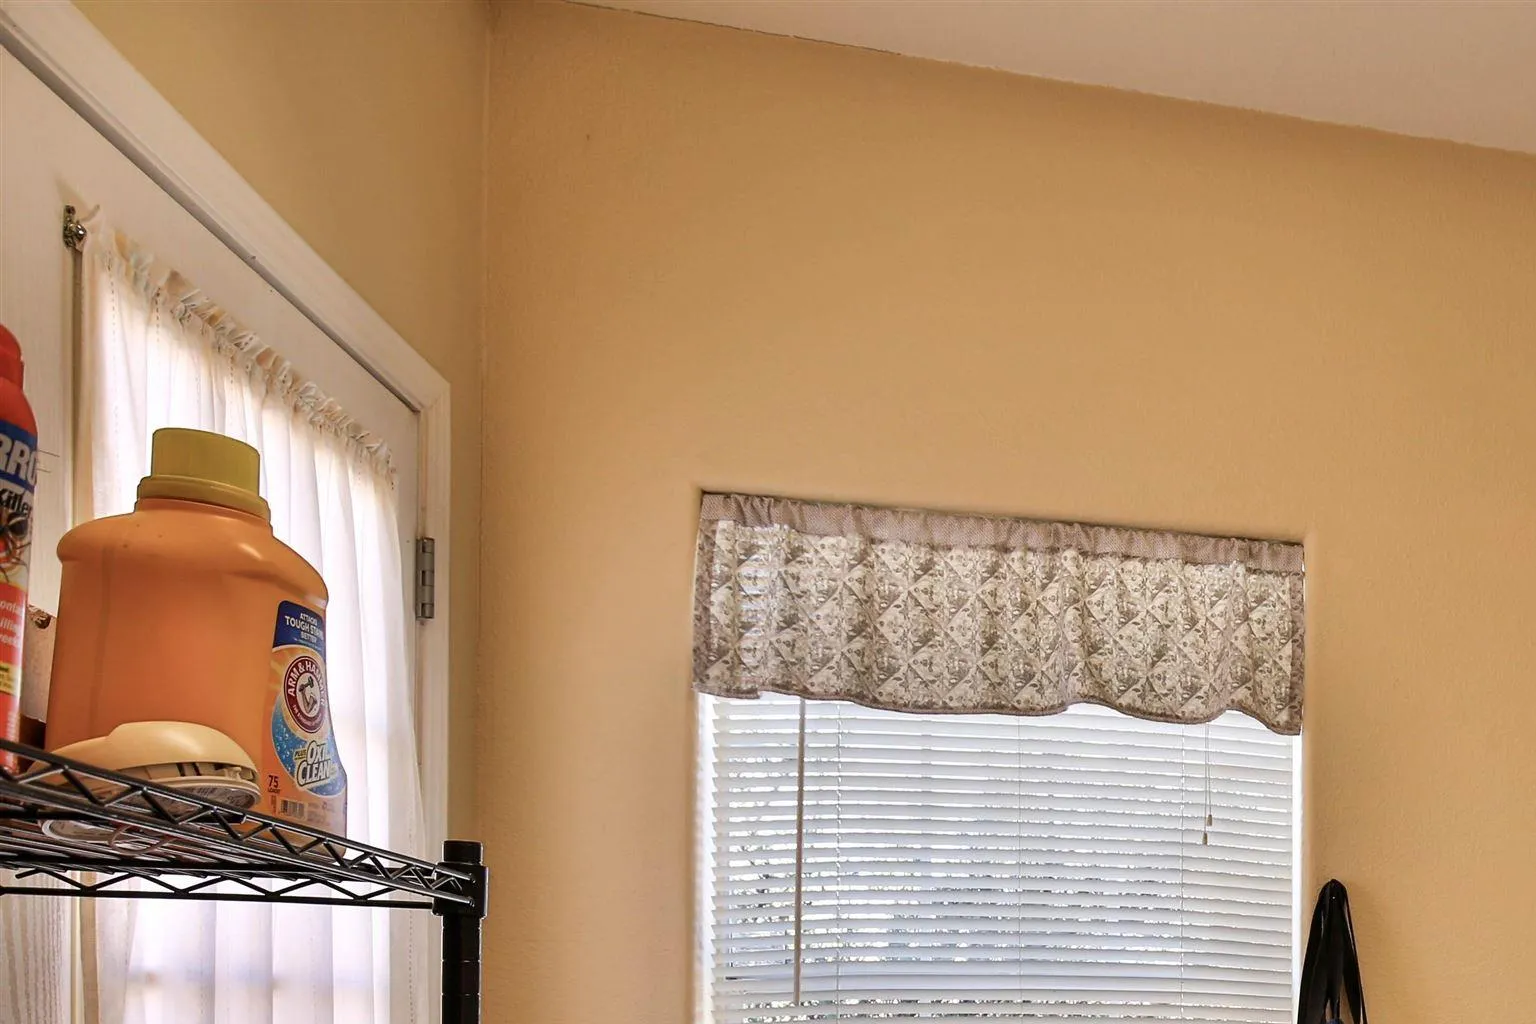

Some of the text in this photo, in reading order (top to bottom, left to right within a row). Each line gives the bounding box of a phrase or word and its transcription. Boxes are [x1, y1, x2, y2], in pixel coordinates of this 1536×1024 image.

[284, 615, 310, 632] TOUGH
[287, 667, 300, 697] ARM
[268, 775, 279, 788] 75
[297, 759, 332, 787] CLEAN
